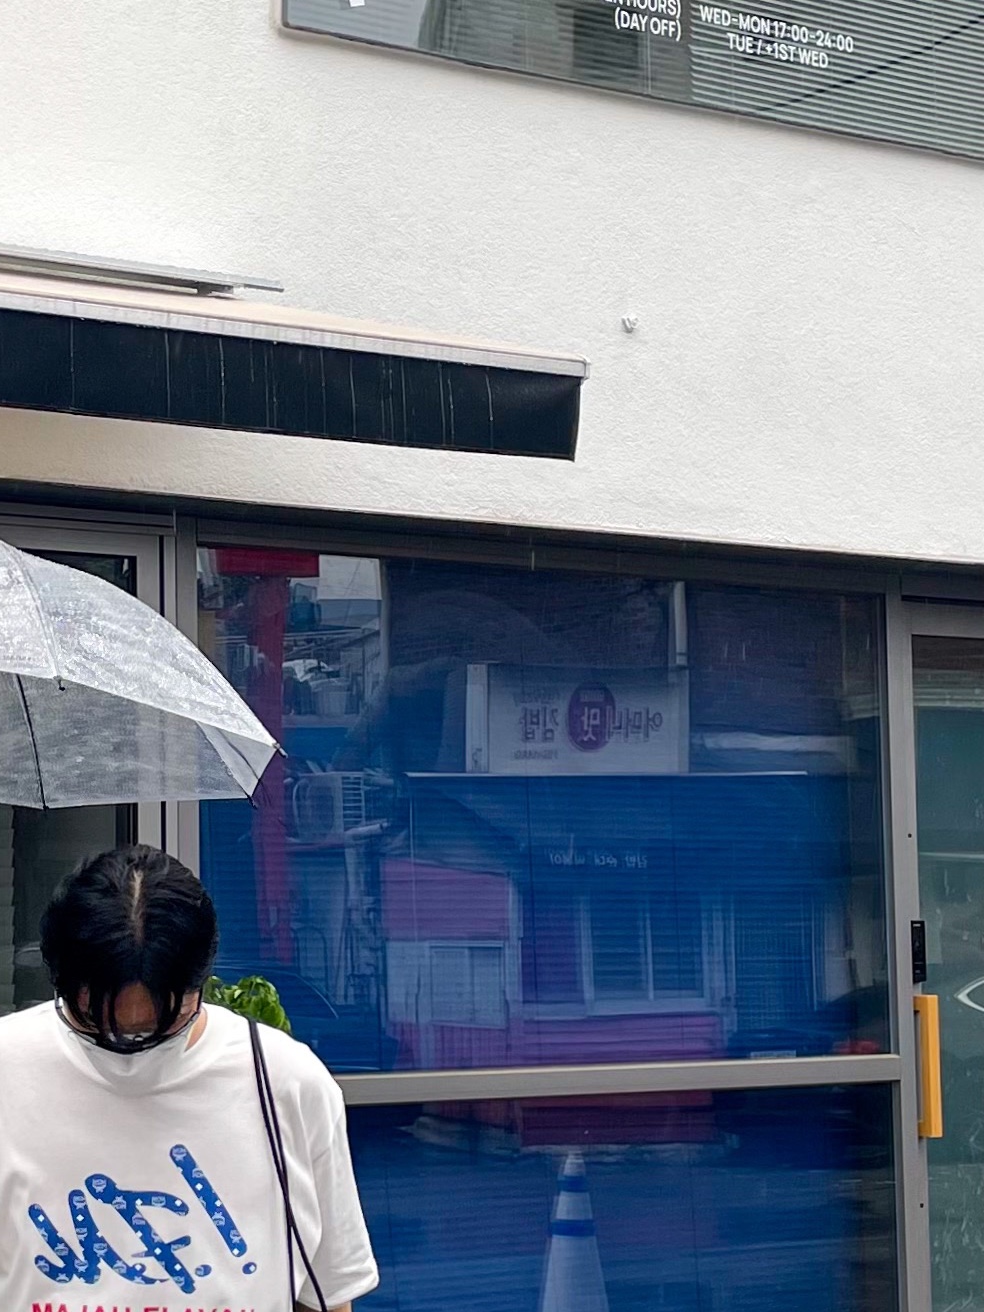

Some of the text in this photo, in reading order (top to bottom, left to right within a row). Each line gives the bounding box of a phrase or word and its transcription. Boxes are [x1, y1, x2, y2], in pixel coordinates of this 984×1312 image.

[615, 7, 681, 42] (DAY OFF)
[699, 5, 854, 53] WED-MON 17:00-24:00
[726, 32, 753, 54] TUE
[798, 48, 829, 68] WED
